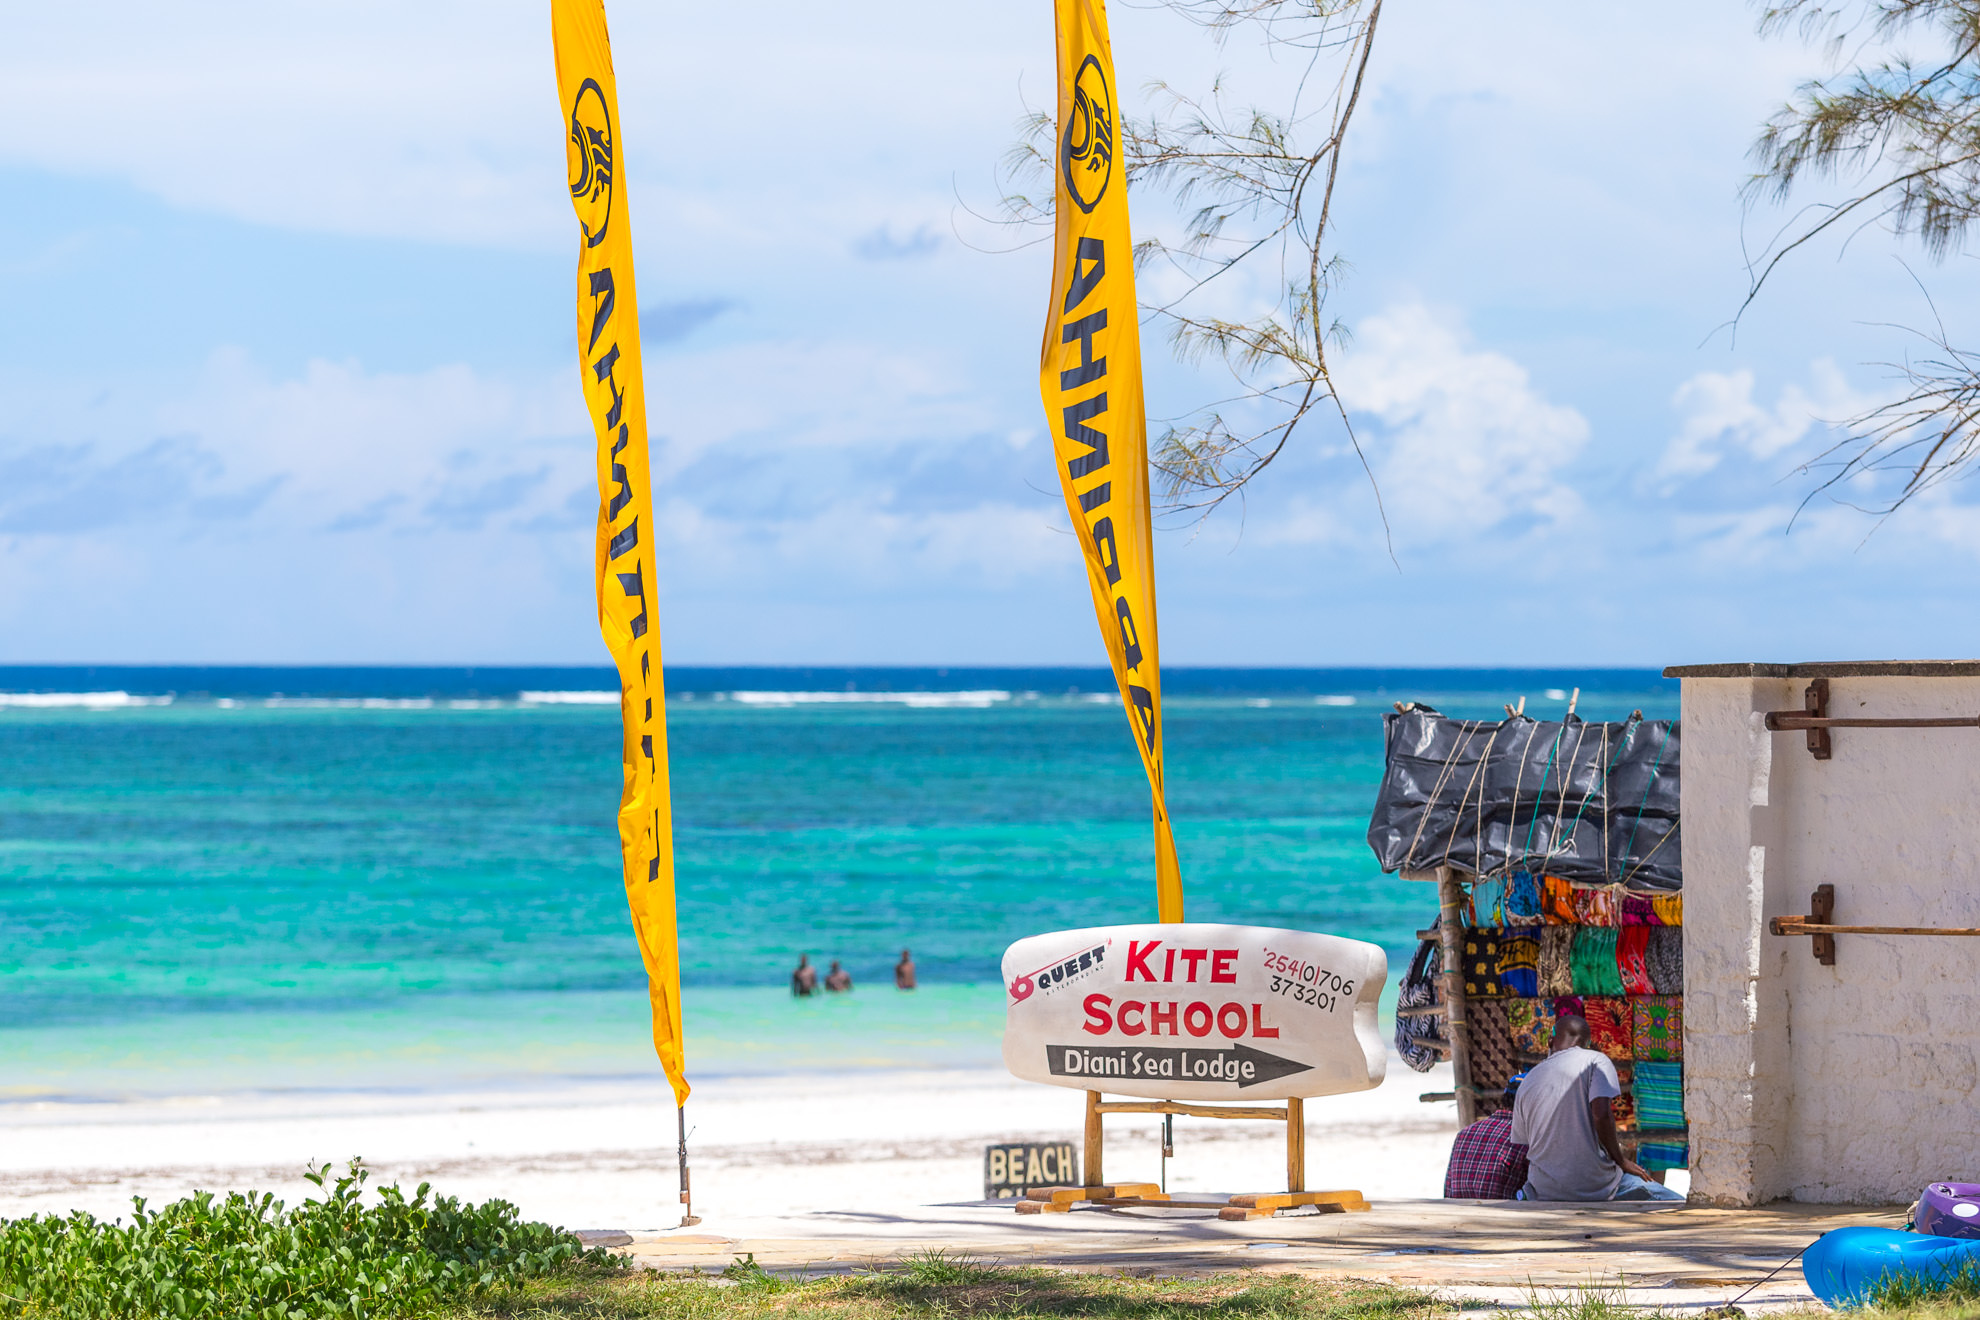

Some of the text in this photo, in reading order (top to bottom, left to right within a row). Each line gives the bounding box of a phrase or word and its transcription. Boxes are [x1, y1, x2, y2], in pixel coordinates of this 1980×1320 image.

[1038, 945, 1105, 990] QUEST
[1124, 940, 1239, 984] KITE
[1270, 975, 1336, 1013] 373201
[1082, 993, 1280, 1039] SCHOOL
[1064, 1049, 1256, 1082] Diani Sea Lodge
[989, 1145, 1074, 1184] BEACH
